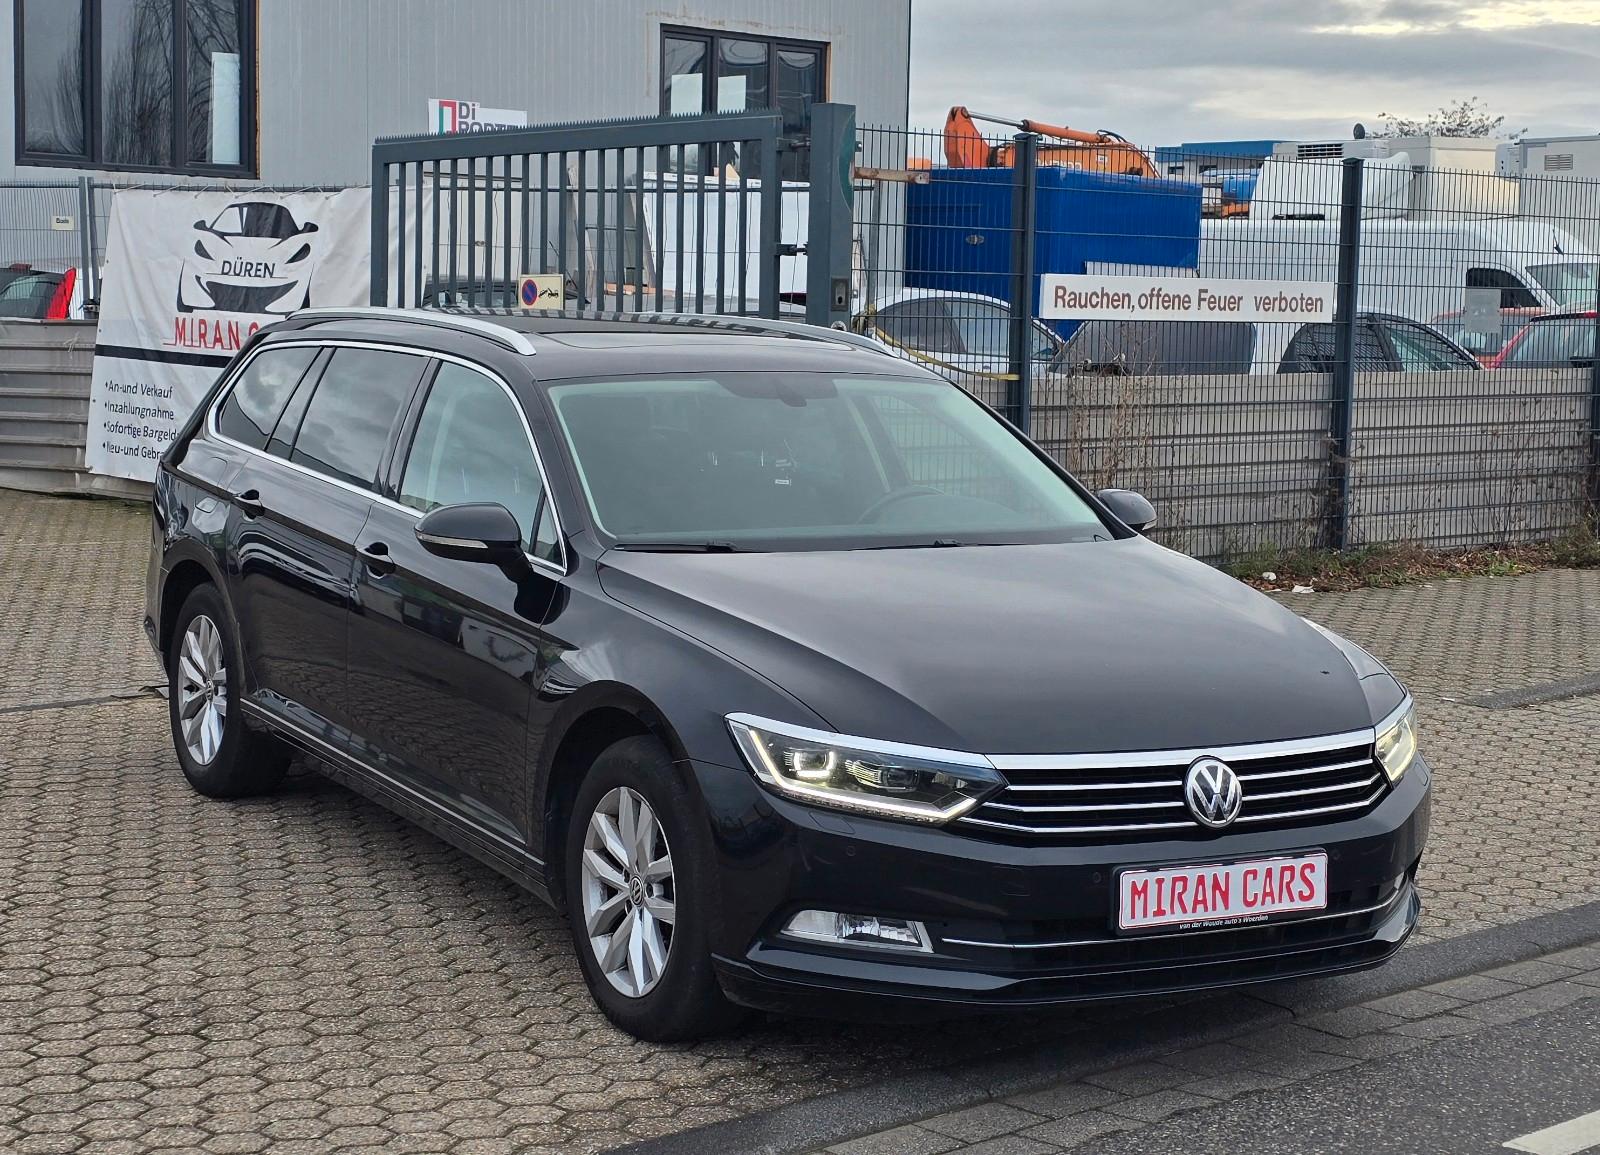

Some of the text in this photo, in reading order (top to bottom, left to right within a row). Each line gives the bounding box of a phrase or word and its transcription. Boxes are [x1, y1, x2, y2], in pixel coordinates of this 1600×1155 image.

[458, 101, 476, 120] Di
[221, 256, 276, 279] DÜREN
[1054, 285, 1324, 313] Rauchen, offene Feuer verboten
[174, 316, 241, 350] MIRAN
[108, 380, 173, 399] An-und Verkauf
[107, 400, 174, 419] Inzahlungnahme
[106, 421, 179, 442] Sofortige Bargeld
[1130, 862, 1316, 920] MIRAN CARS
